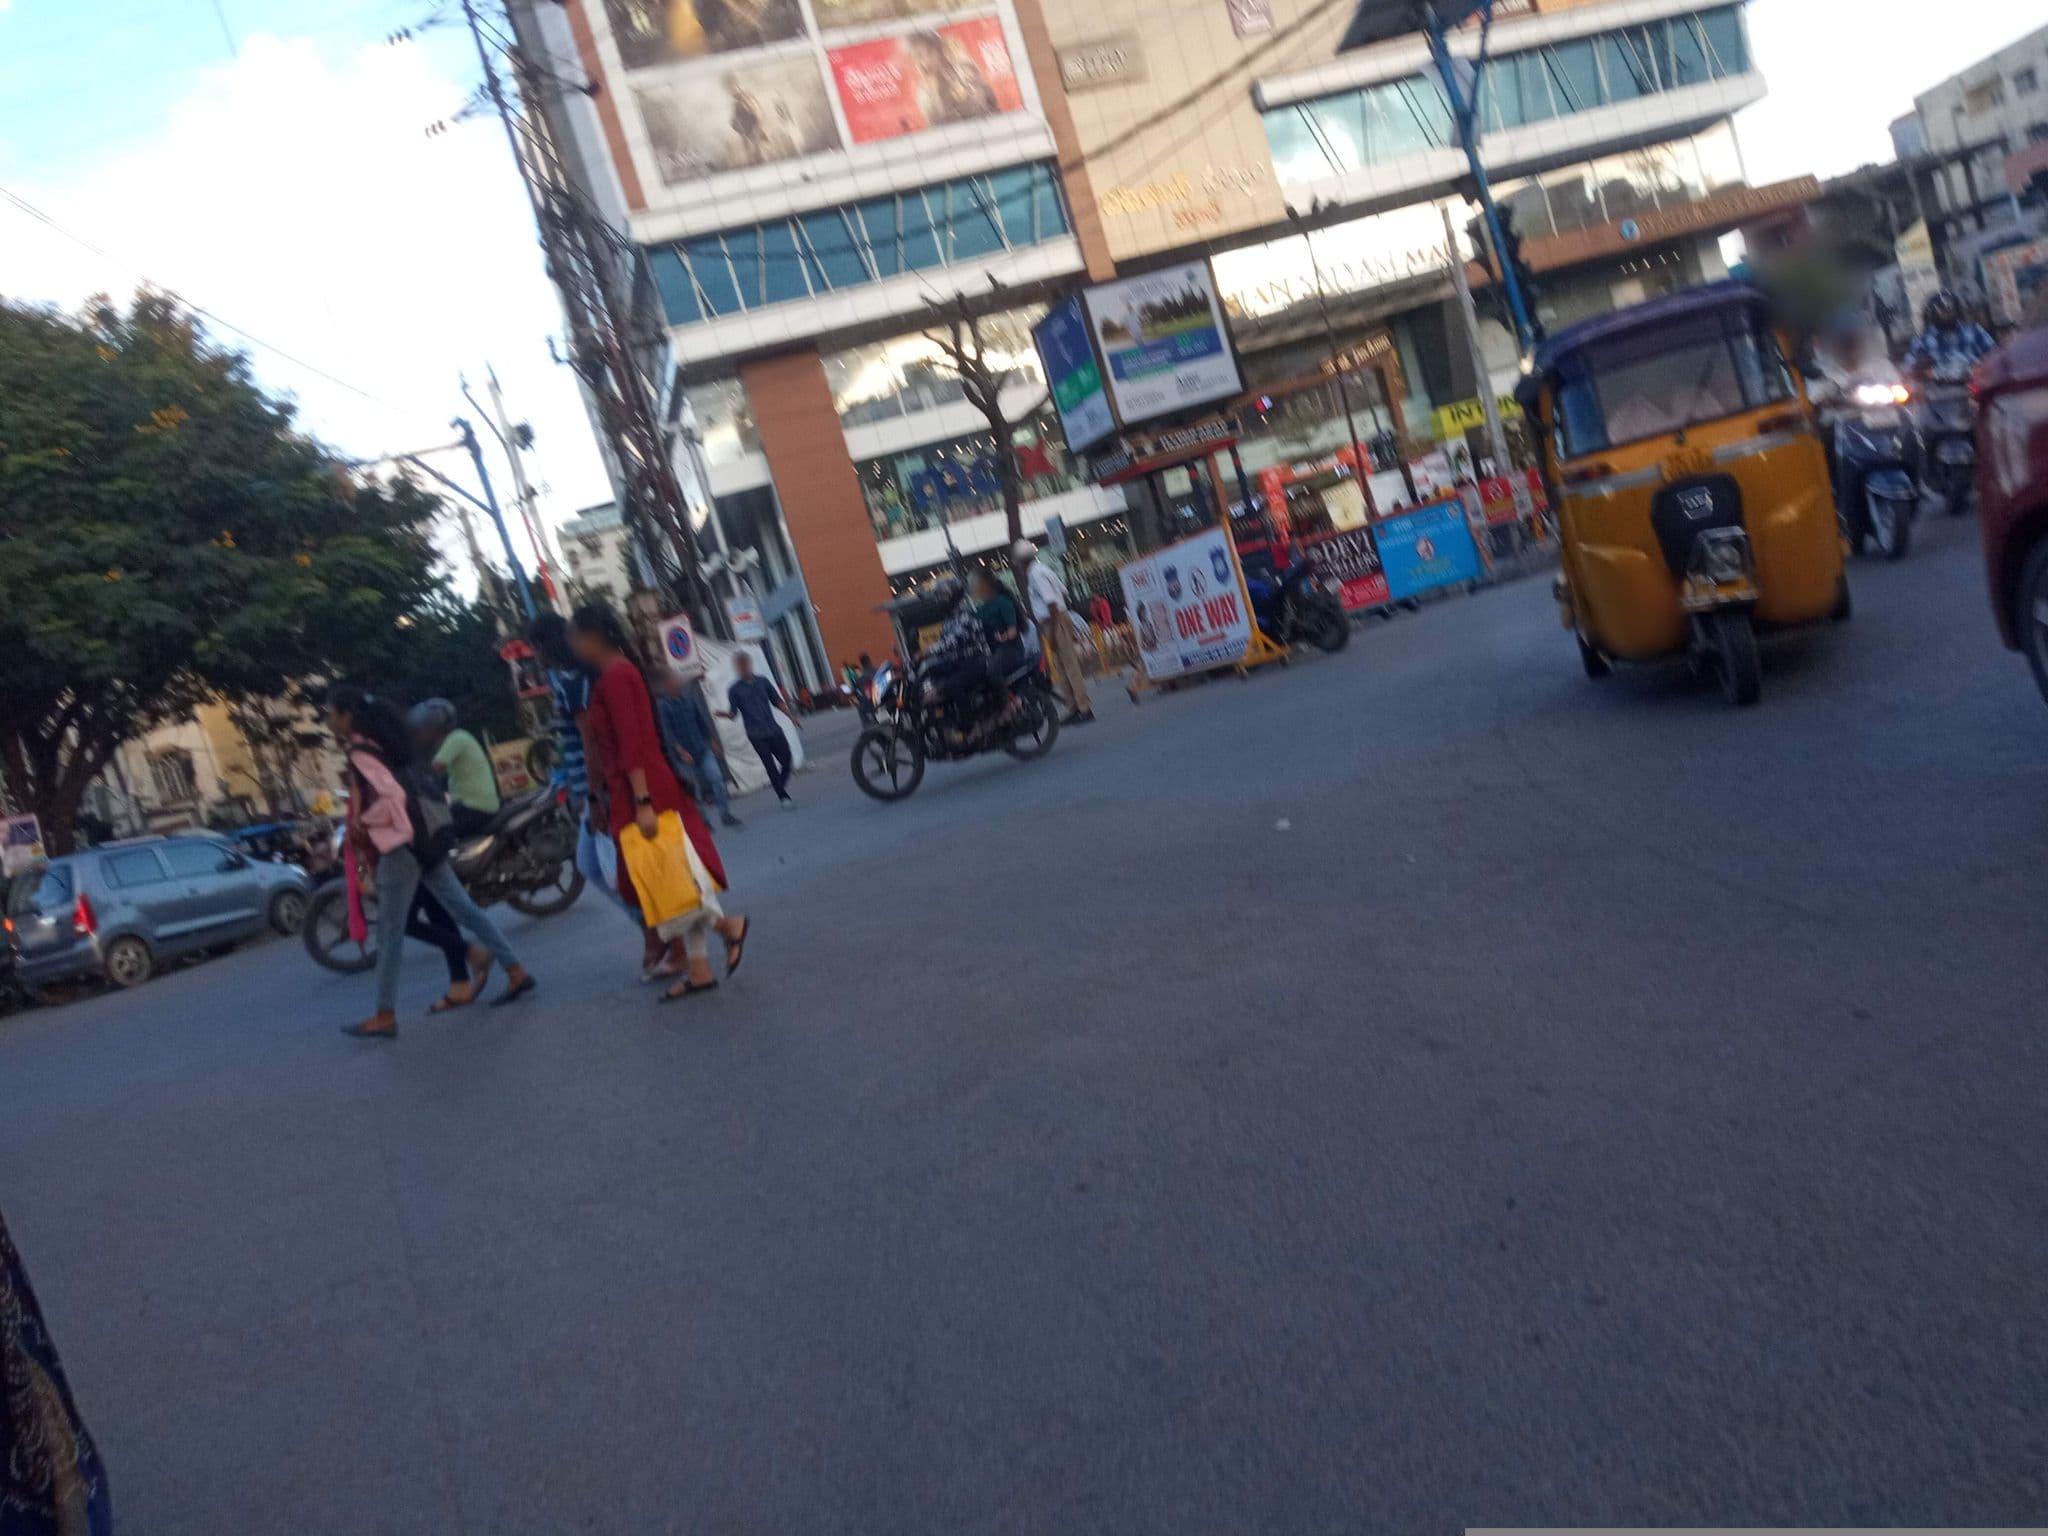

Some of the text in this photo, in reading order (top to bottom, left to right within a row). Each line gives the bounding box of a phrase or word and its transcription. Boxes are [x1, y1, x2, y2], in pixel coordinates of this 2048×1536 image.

[1321, 530, 1372, 563] DEVI
[1175, 592, 1240, 640] ONE WAY
